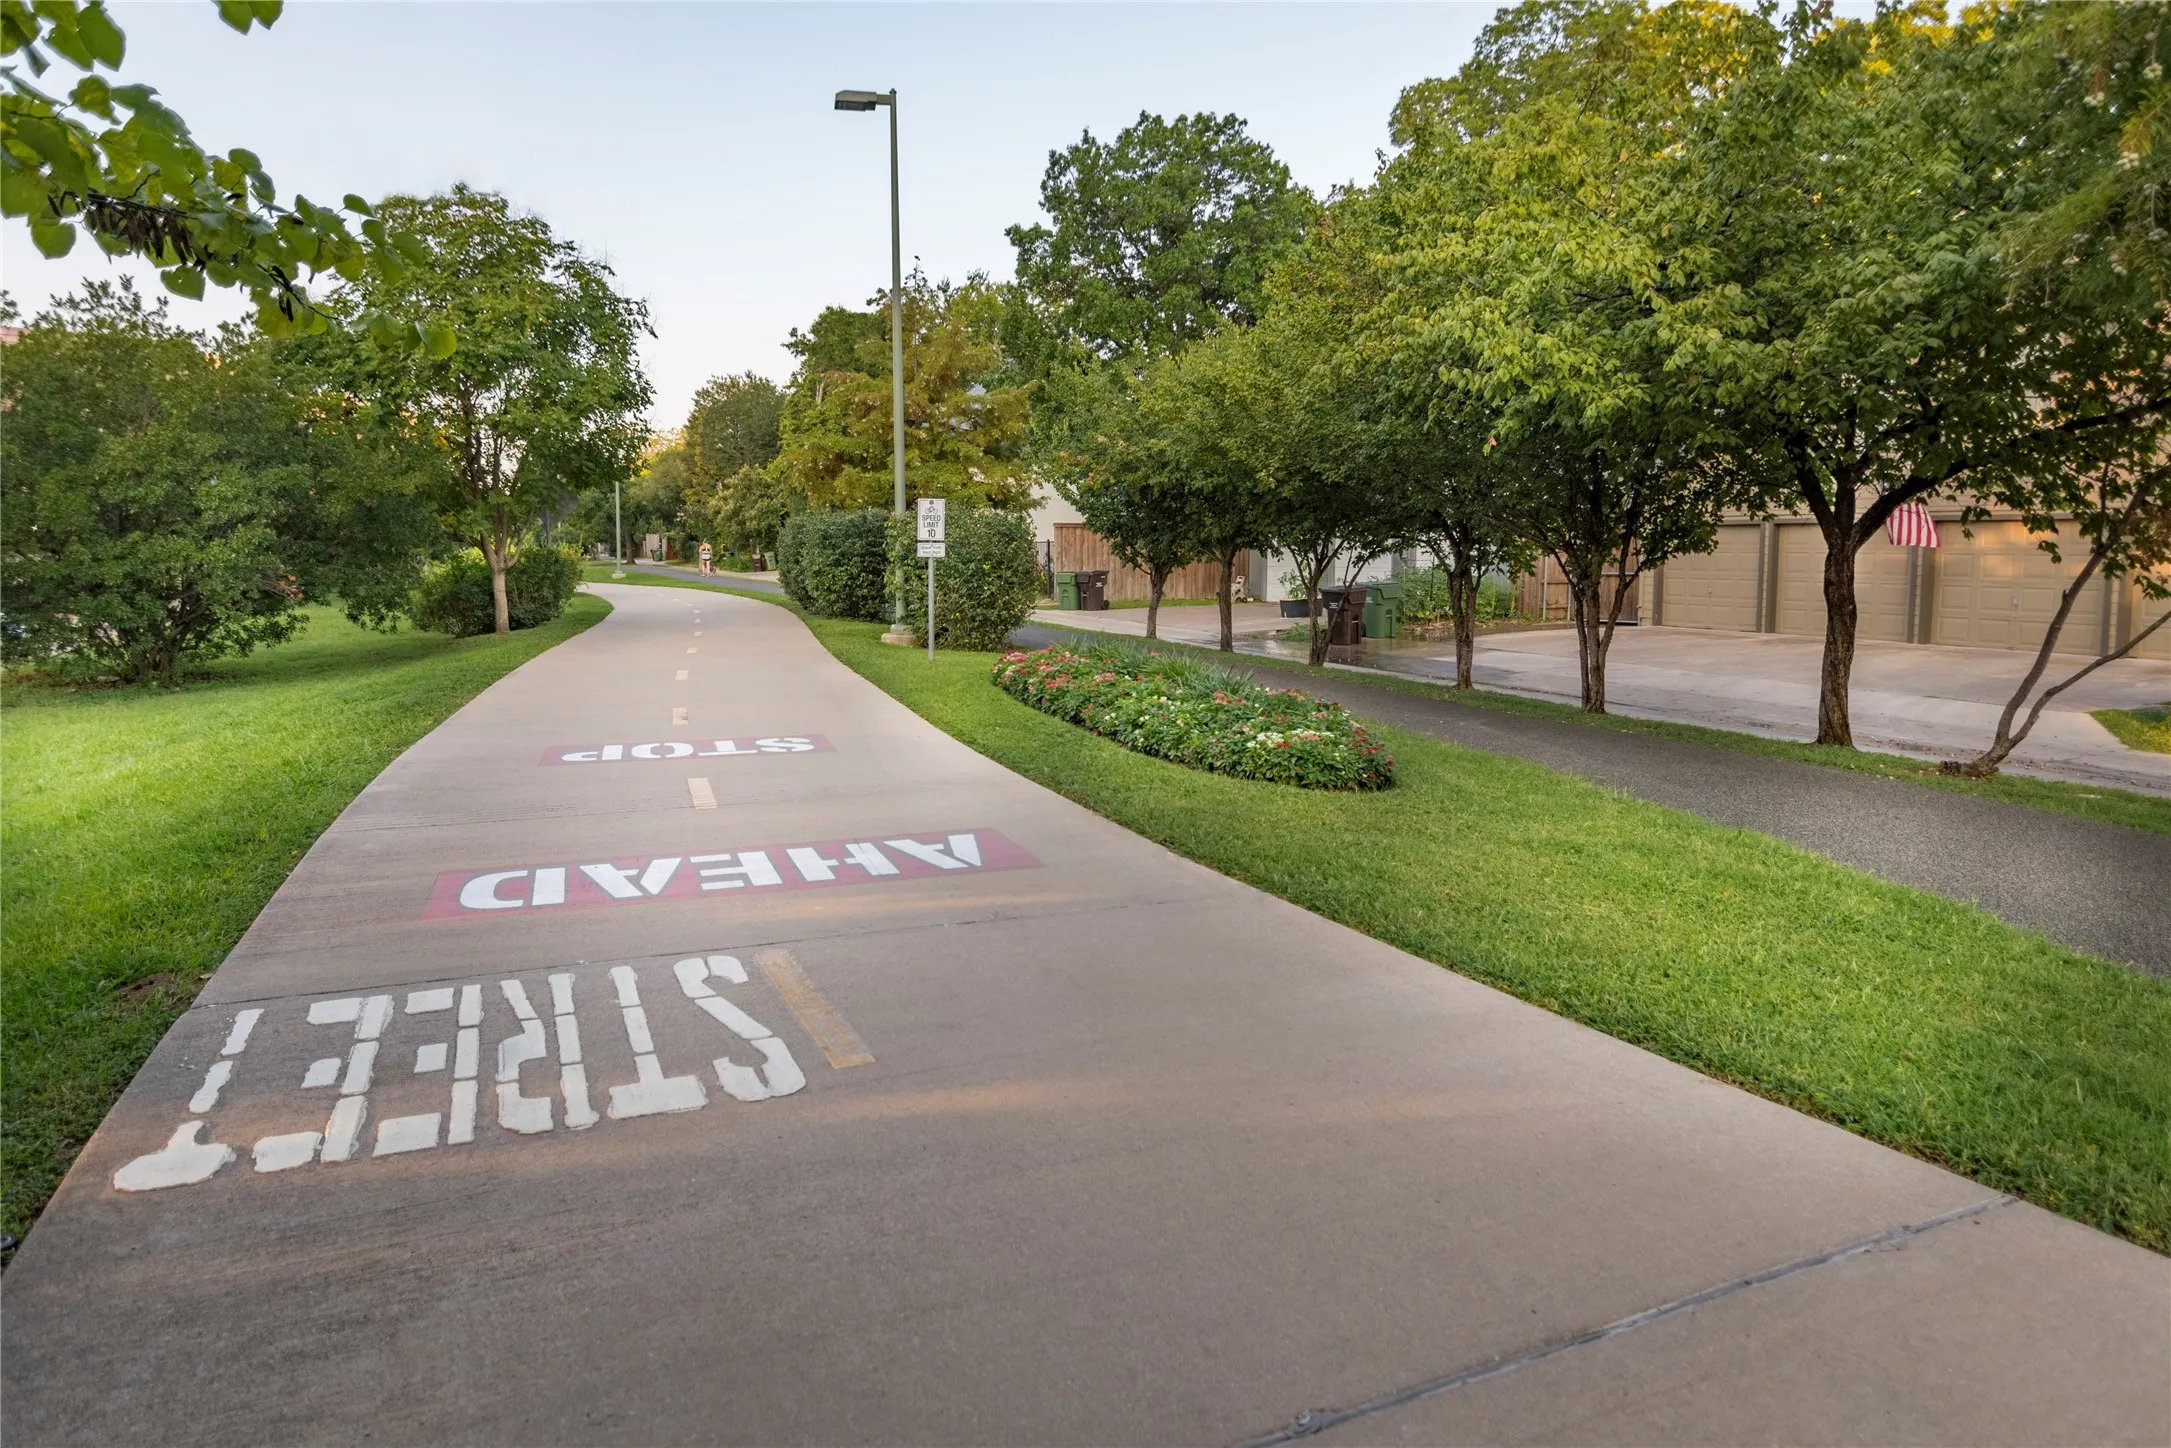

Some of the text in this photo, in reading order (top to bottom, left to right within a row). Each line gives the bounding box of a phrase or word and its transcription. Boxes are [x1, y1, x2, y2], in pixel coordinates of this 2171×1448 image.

[927, 529, 936, 538] 10
[560, 735, 817, 763] STOP
[458, 832, 983, 910] AHEAD
[112, 954, 807, 1192] STREET
